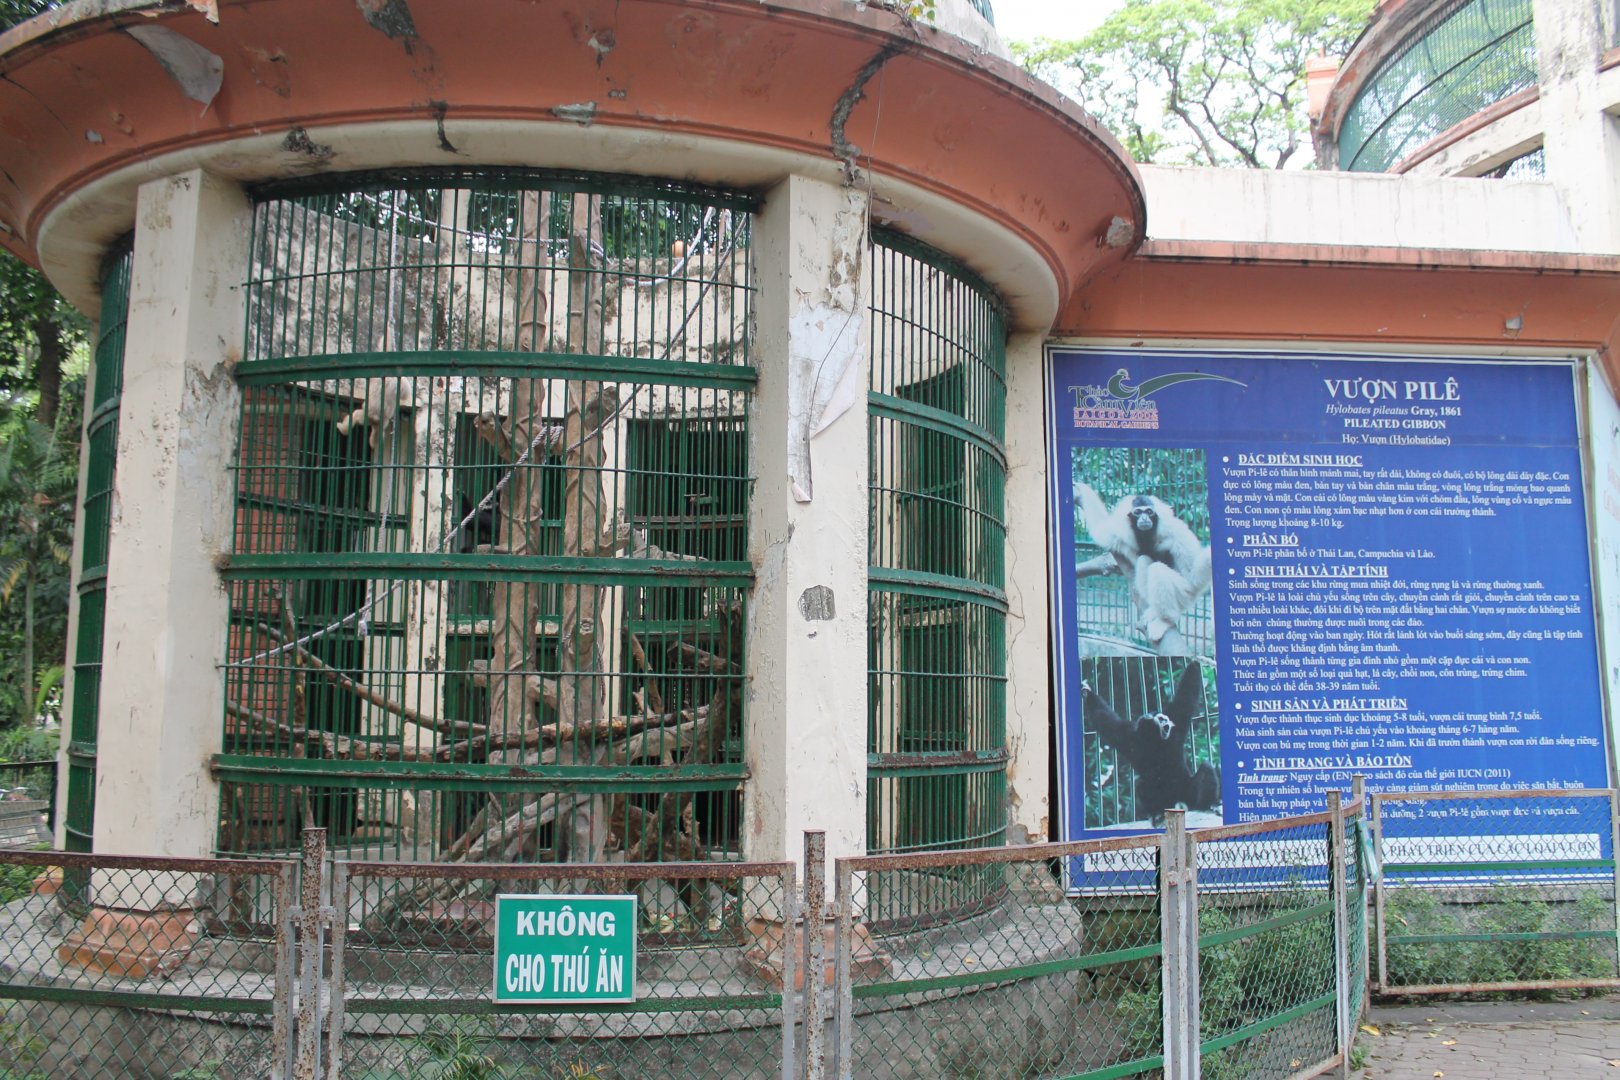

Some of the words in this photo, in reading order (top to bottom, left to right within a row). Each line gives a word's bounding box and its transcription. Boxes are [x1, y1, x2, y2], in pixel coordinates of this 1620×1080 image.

[1324, 379, 1397, 404] VƯỢN
[1404, 377, 1460, 400] PILÊ
[1326, 404, 1371, 416] Hylobates
[1372, 405, 1409, 418] pileatus
[1410, 406, 1439, 418] Gray,
[1440, 406, 1462, 416] 1861
[1344, 418, 1400, 428] PILEATED
[1402, 419, 1446, 429] GIBBON
[1342, 434, 1360, 445] Họ:
[1361, 434, 1388, 445] Vượn
[1389, 434, 1451, 447] (Hylobatidae)
[1238, 453, 1265, 466] ĐẶC
[1303, 454, 1333, 467] SINH
[1335, 455, 1362, 468] HỌC
[1343, 468, 1362, 479] mai,
[1362, 470, 1376, 480] tay
[1552, 471, 1570, 480] Con
[1310, 518, 1330, 527] 8-10
[1331, 518, 1345, 529] kg.
[1243, 532, 1278, 547] PHÂN
[1338, 549, 1357, 559] Lan,
[1358, 549, 1404, 560] Campuchia
[1244, 566, 1276, 577] SINH
[1331, 564, 1356, 578] TẬP
[1228, 580, 1248, 589] Sinh
[1271, 581, 1294, 591] trong
[1311, 579, 1328, 589] khu
[1522, 580, 1545, 589] xanh.
[1368, 619, 1391, 630] trong
[1315, 681, 1340, 691] 38-39
[1251, 700, 1282, 713] SINH
[517, 905, 616, 936] KHÔNG
[505, 953, 546, 992] CHO
[551, 945, 590, 993] THÚ
[595, 947, 623, 993] ĂN
